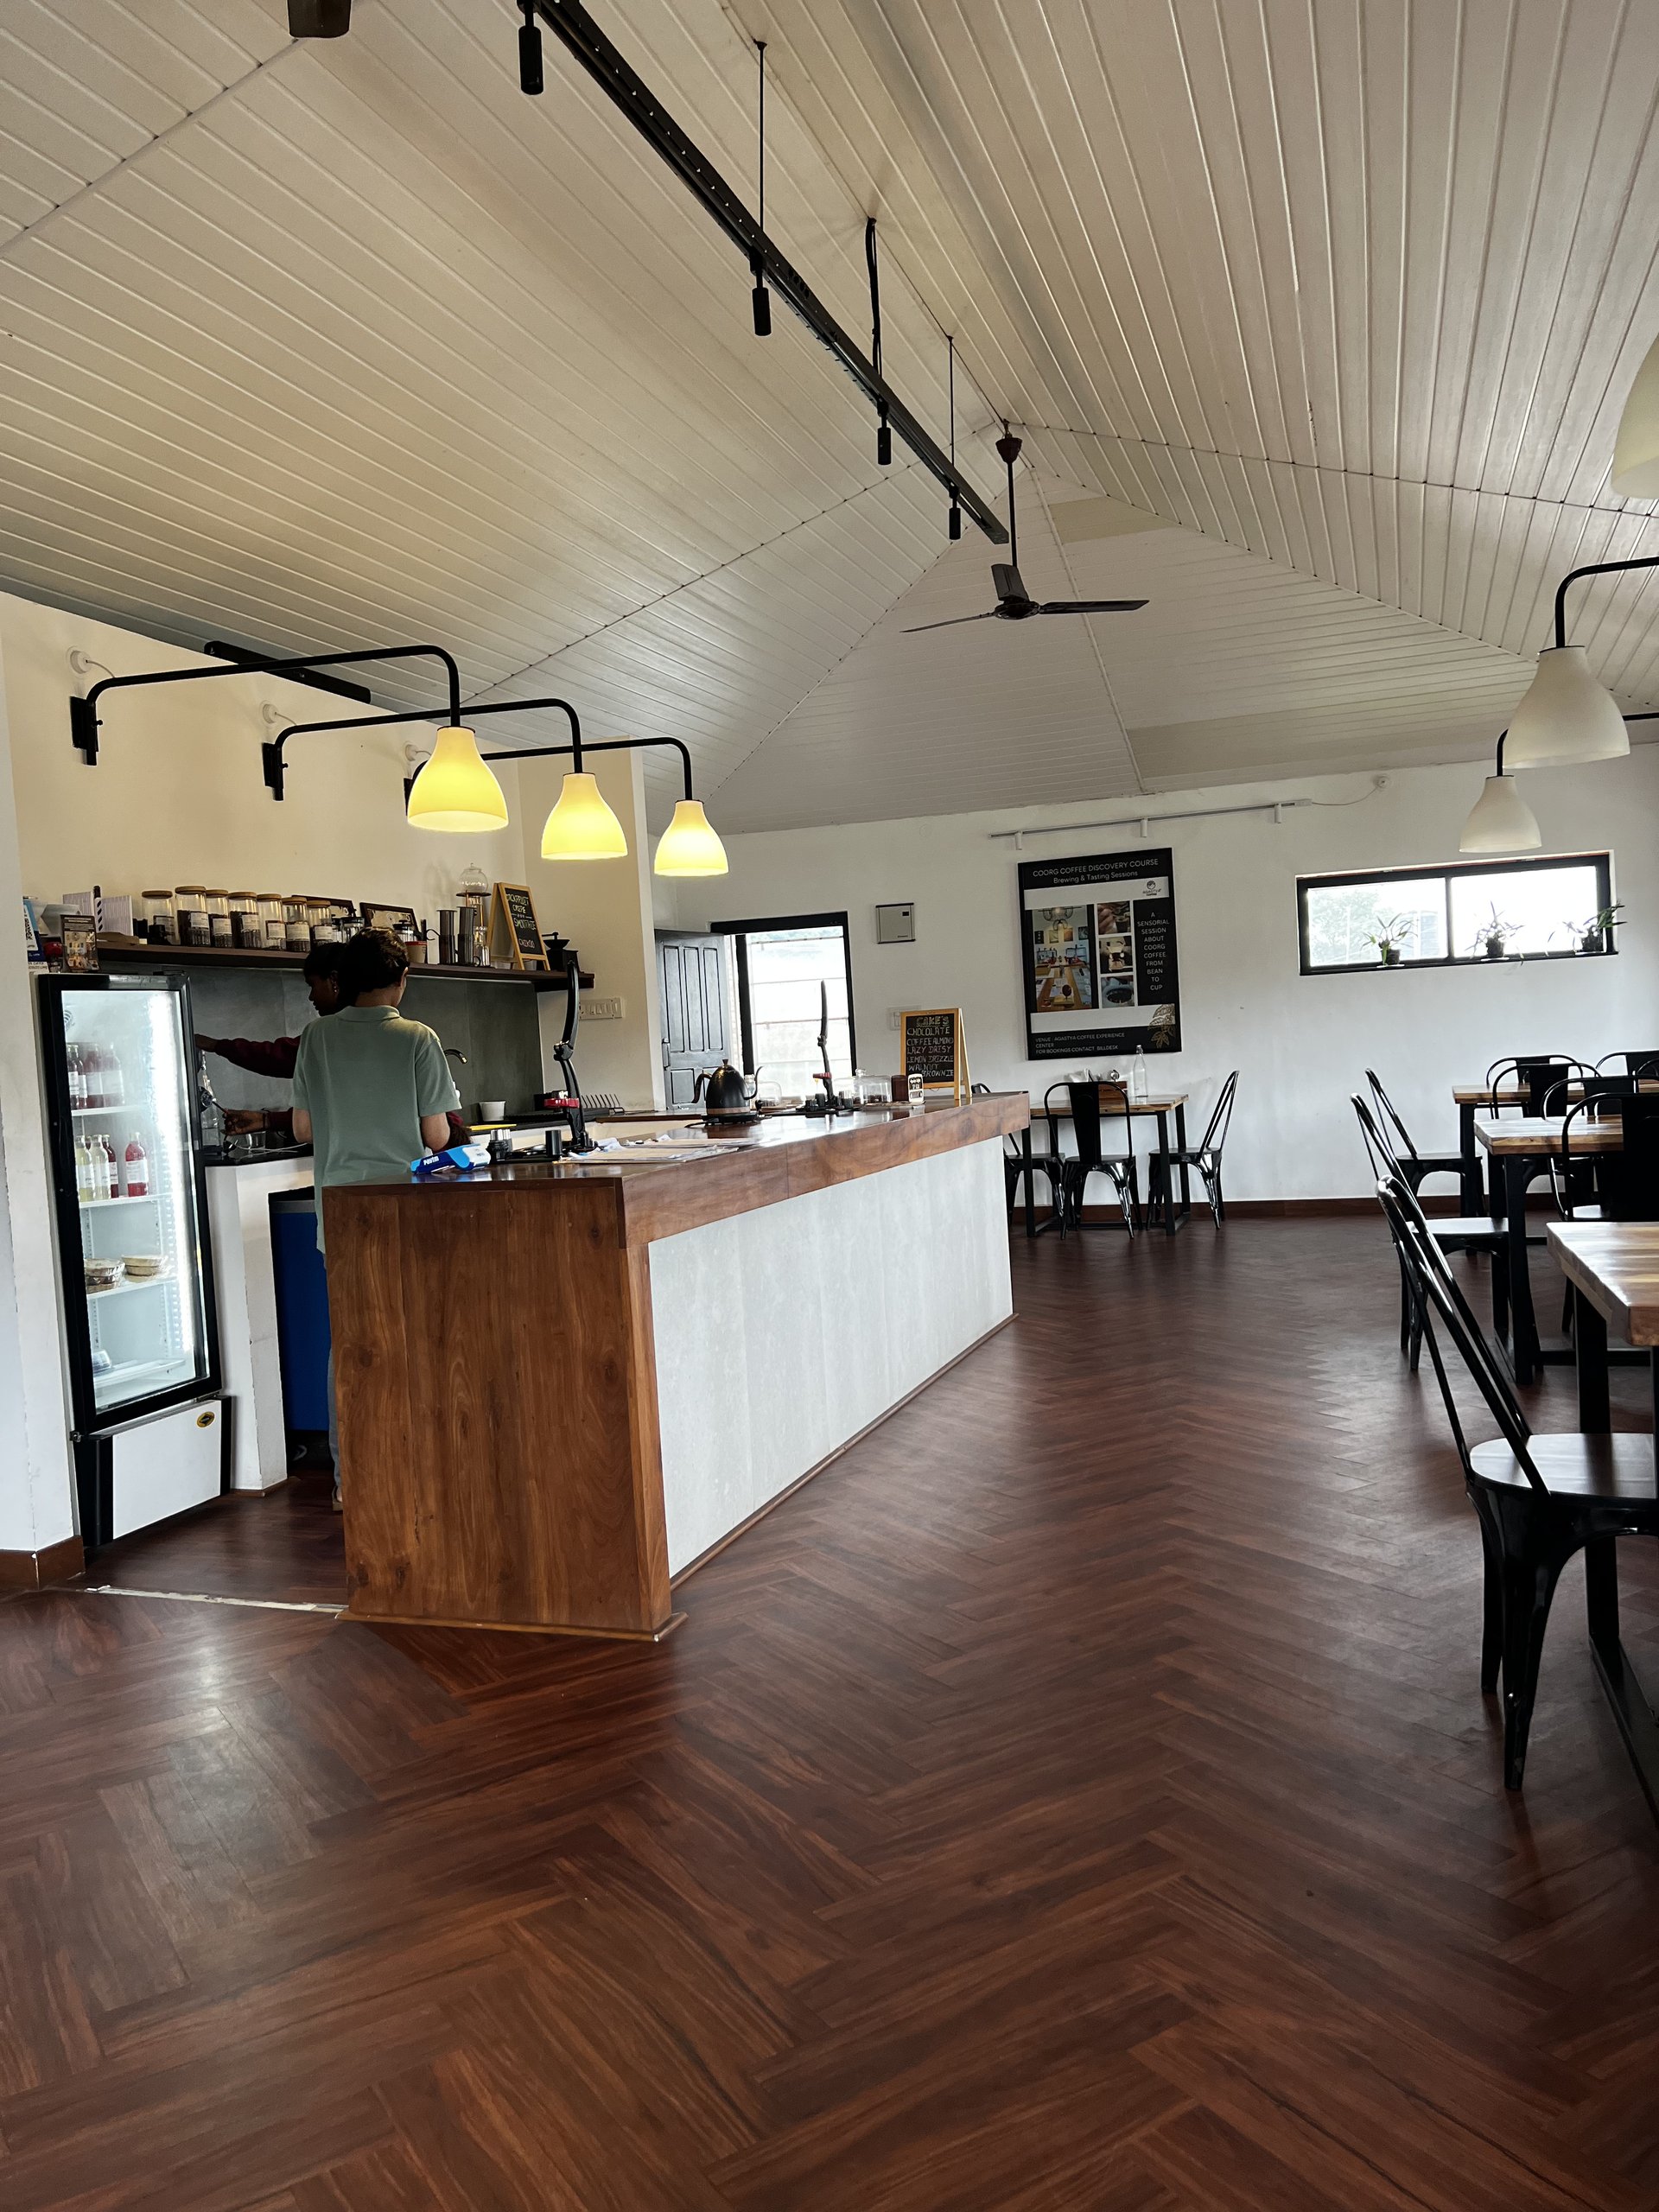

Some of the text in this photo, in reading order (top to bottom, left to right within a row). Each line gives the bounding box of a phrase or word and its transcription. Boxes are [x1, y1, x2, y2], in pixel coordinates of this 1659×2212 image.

[1033, 858, 1159, 877] COORG COFFEE DISCOVERY COURSE
[1111, 870, 1138, 879] Sessions
[916, 1015, 950, 1026] CAKE'S
[906, 1027, 950, 1036] CHOCOLATE
[906, 1037, 932, 1046] COFFEE
[907, 1046, 927, 1054] LAZY
[908, 1063, 939, 1071] WALNUT
